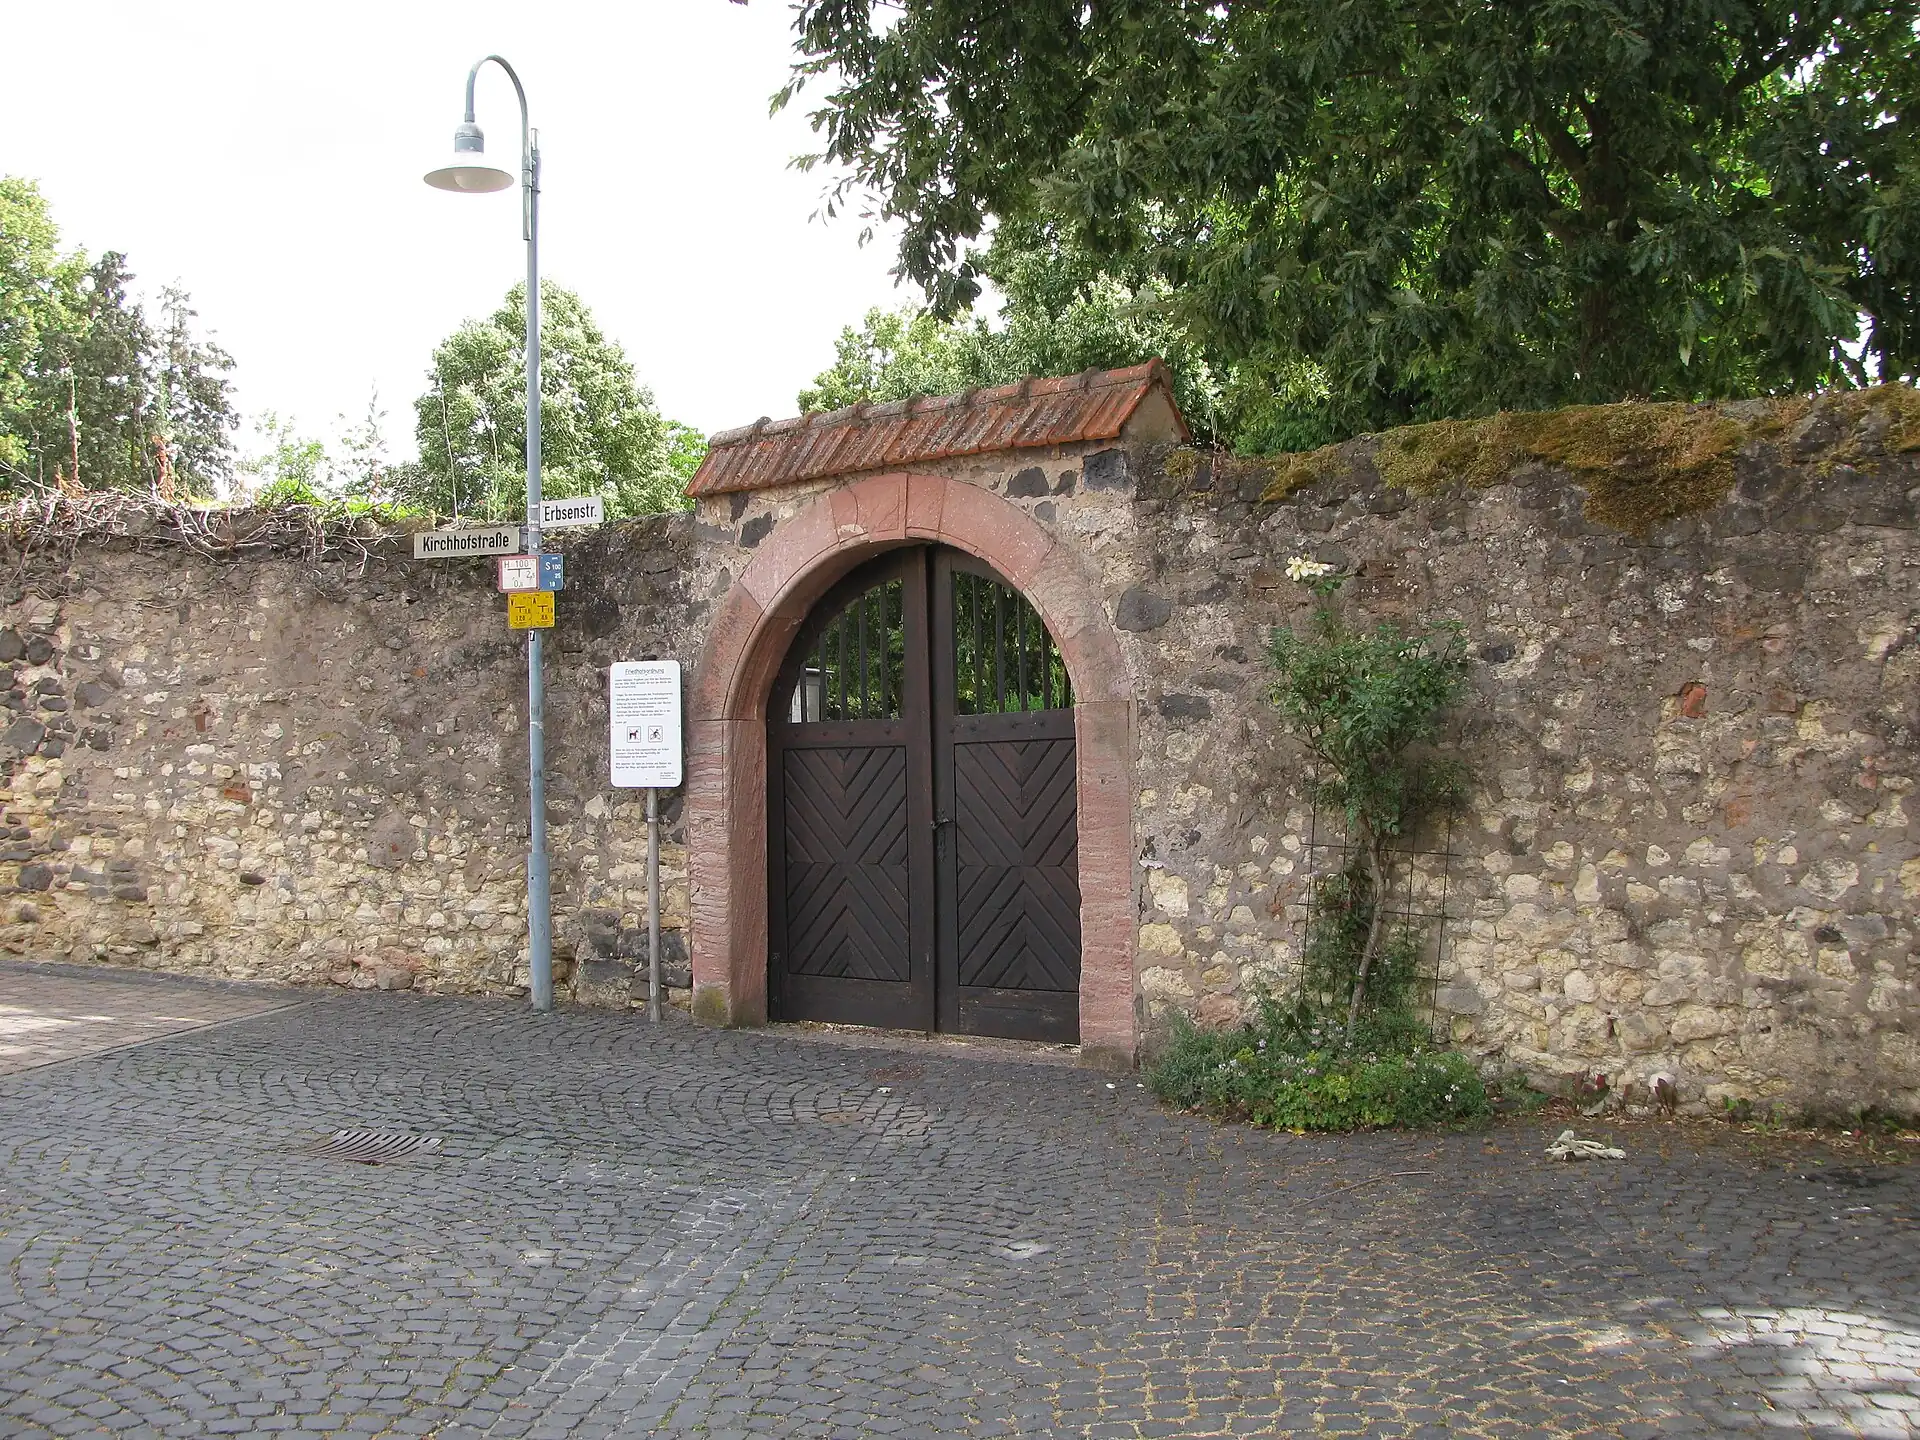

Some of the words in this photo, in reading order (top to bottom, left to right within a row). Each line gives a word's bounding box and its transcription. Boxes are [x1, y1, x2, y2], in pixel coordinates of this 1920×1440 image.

[544, 503, 597, 522] Erbsenstr.
[422, 532, 509, 552] Kirchhofstraße
[504, 560, 509, 568] H
[515, 560, 528, 568] 100
[545, 562, 551, 570] S
